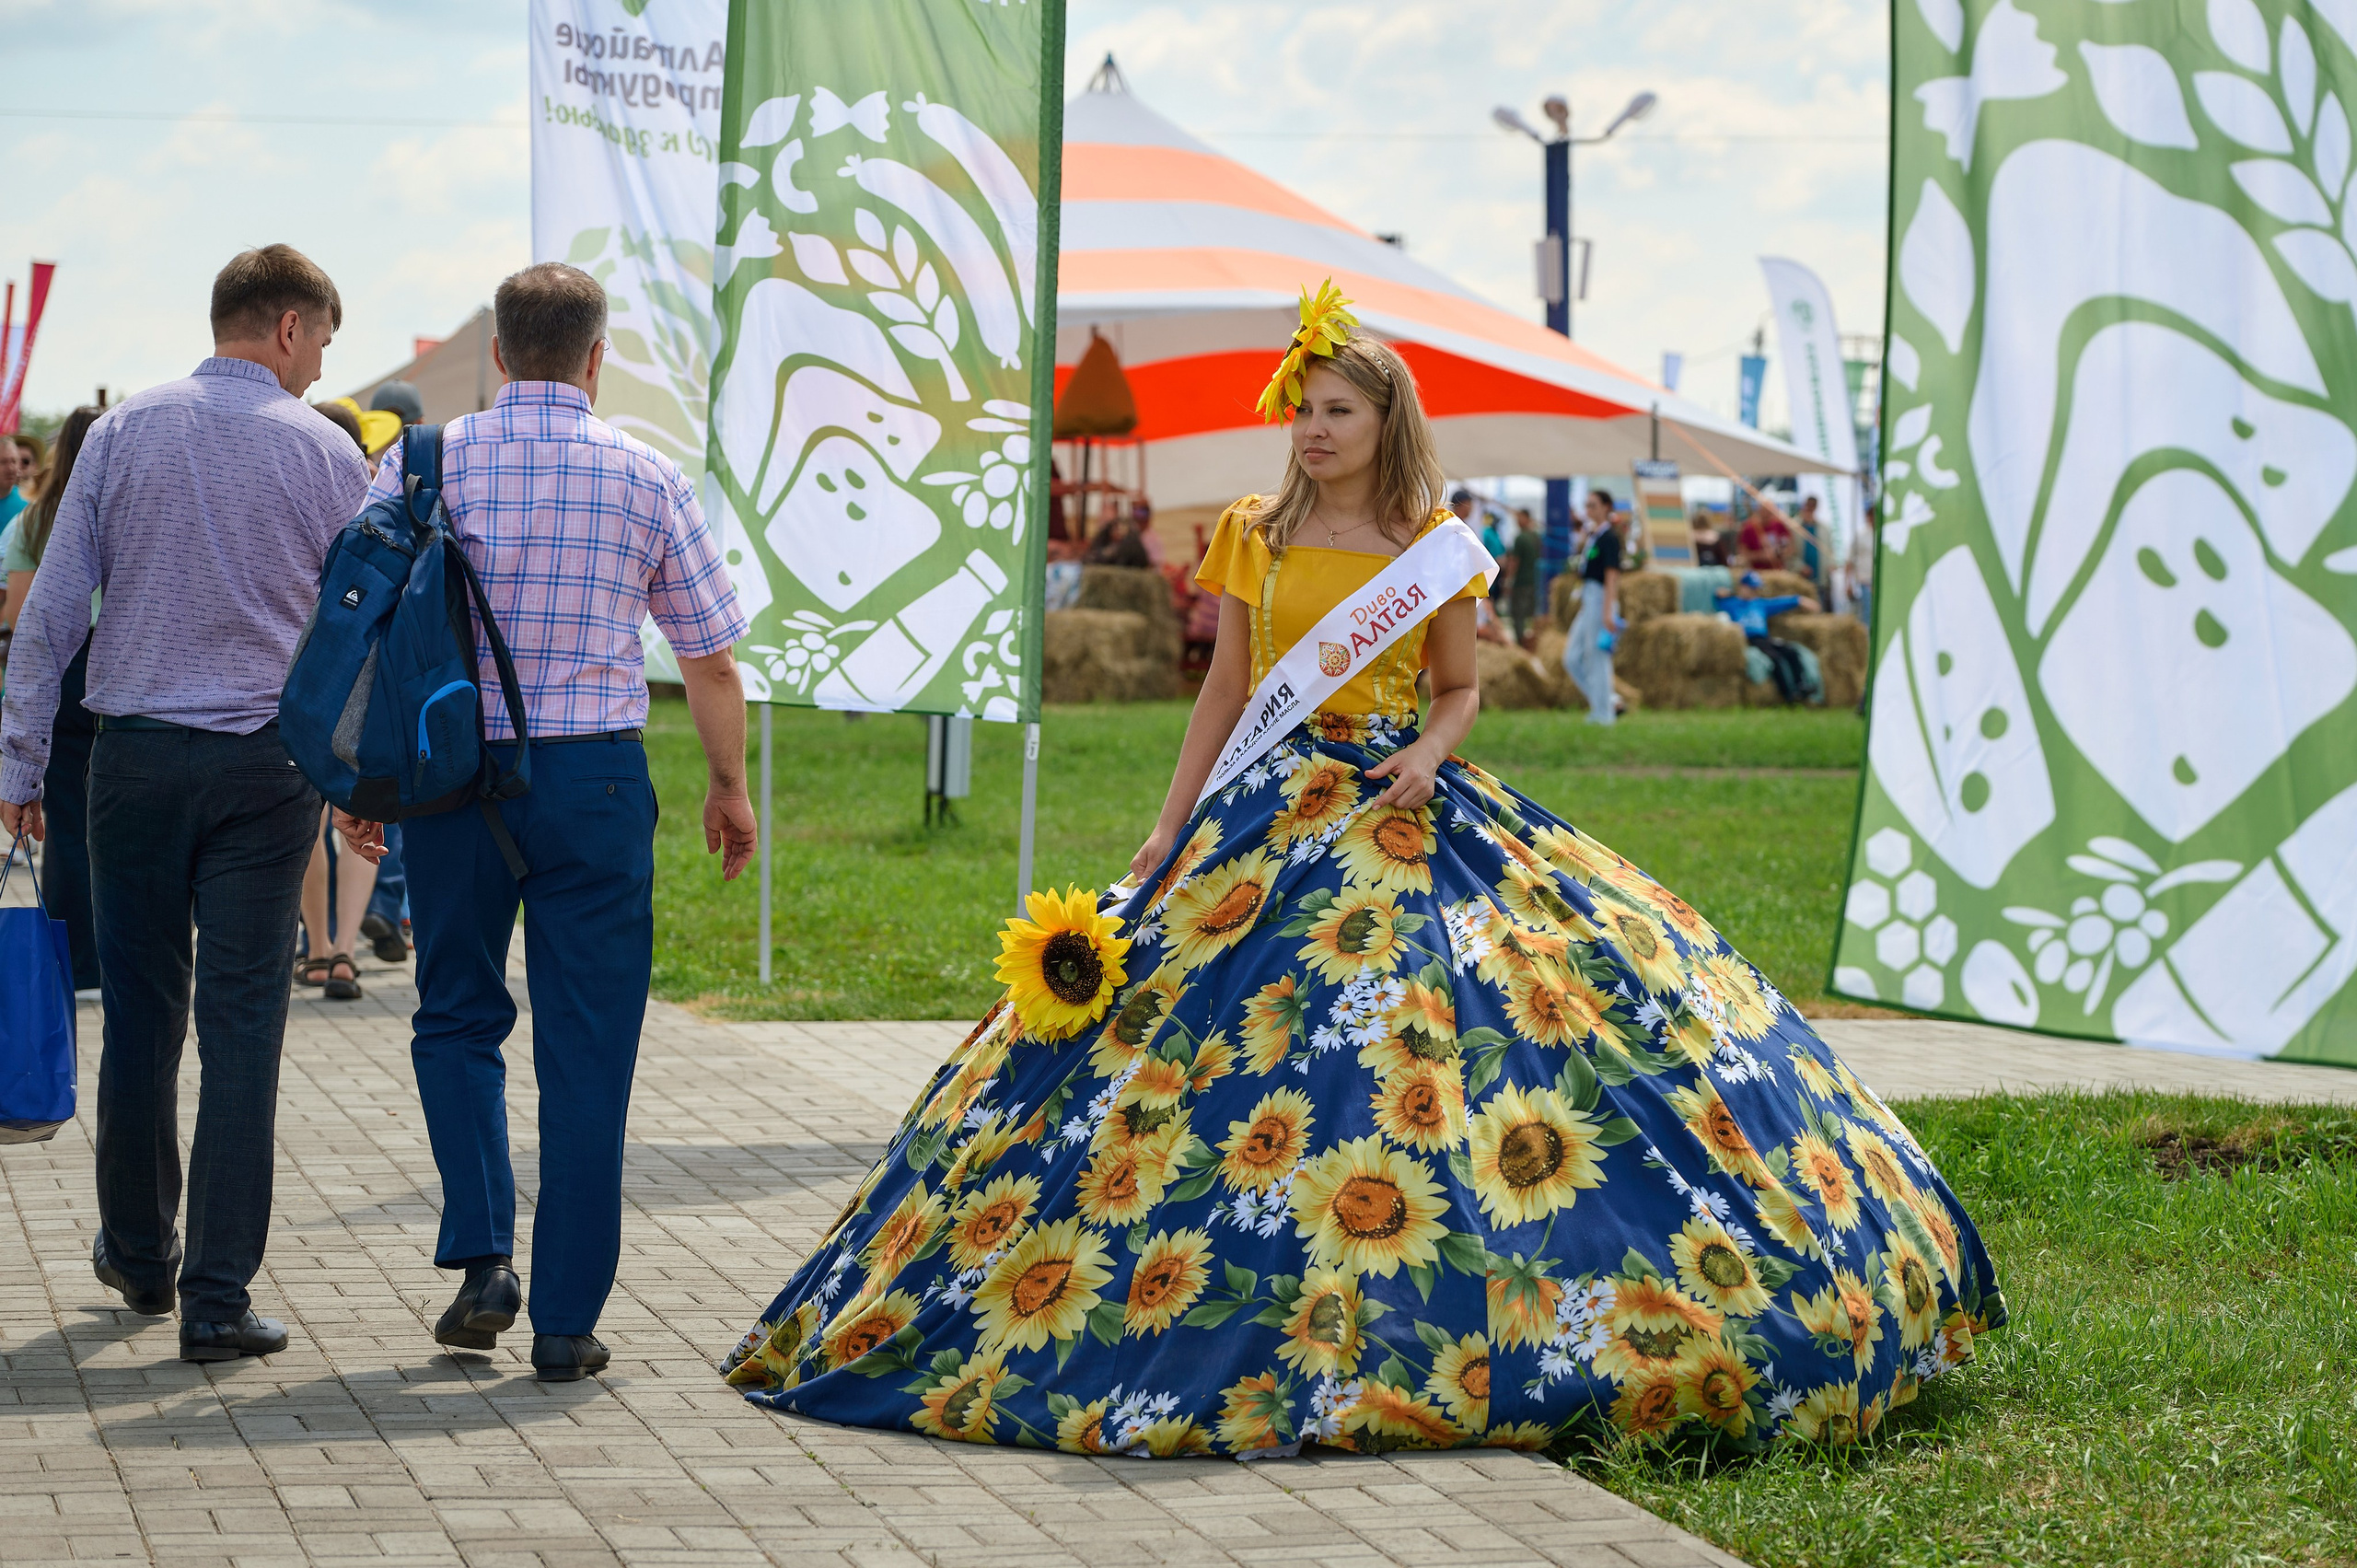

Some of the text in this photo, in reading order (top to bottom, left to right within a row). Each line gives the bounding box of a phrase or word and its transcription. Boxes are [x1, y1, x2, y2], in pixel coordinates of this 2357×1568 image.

[1349, 587, 1396, 626] Диво
[1279, 699, 1300, 718] МАСЛА
[1216, 682, 1295, 775] АЛТАРИЯ
